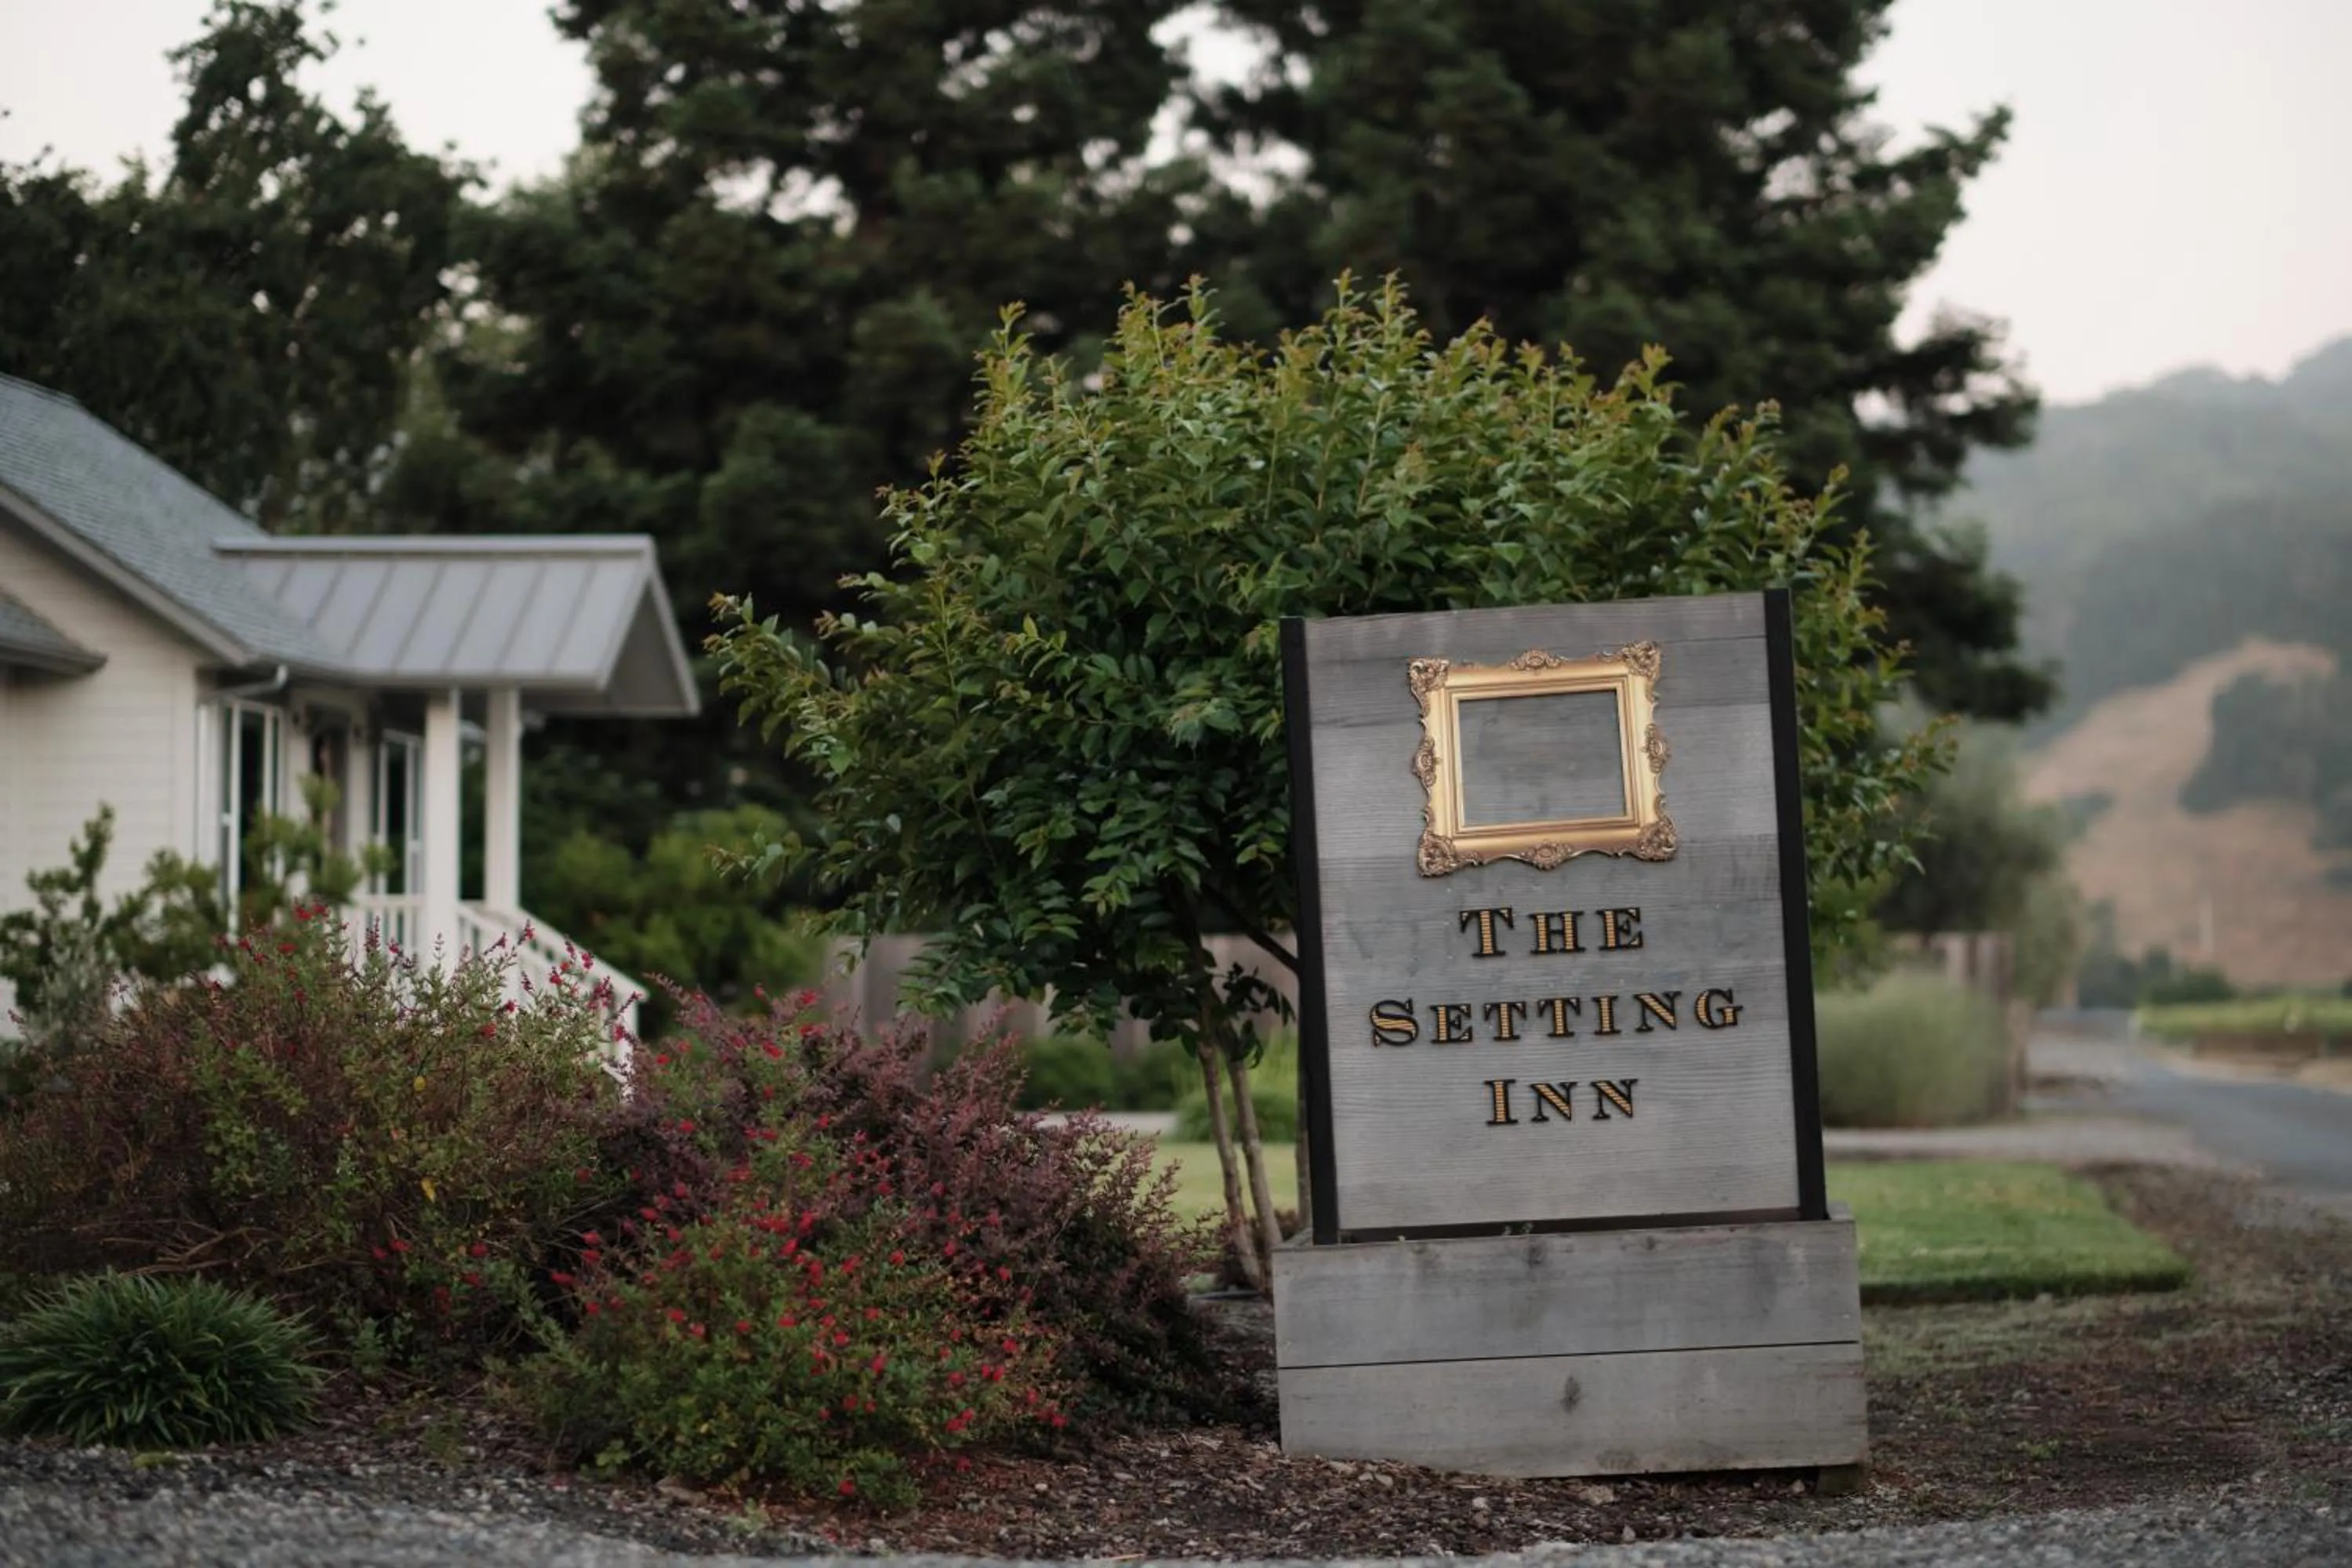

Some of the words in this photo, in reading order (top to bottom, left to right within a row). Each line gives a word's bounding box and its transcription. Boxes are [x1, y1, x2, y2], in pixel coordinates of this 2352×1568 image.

[1460, 907, 1643, 958] THE
[1369, 989, 1743, 1047] SETTING
[1485, 1079, 1638, 1126] INN
